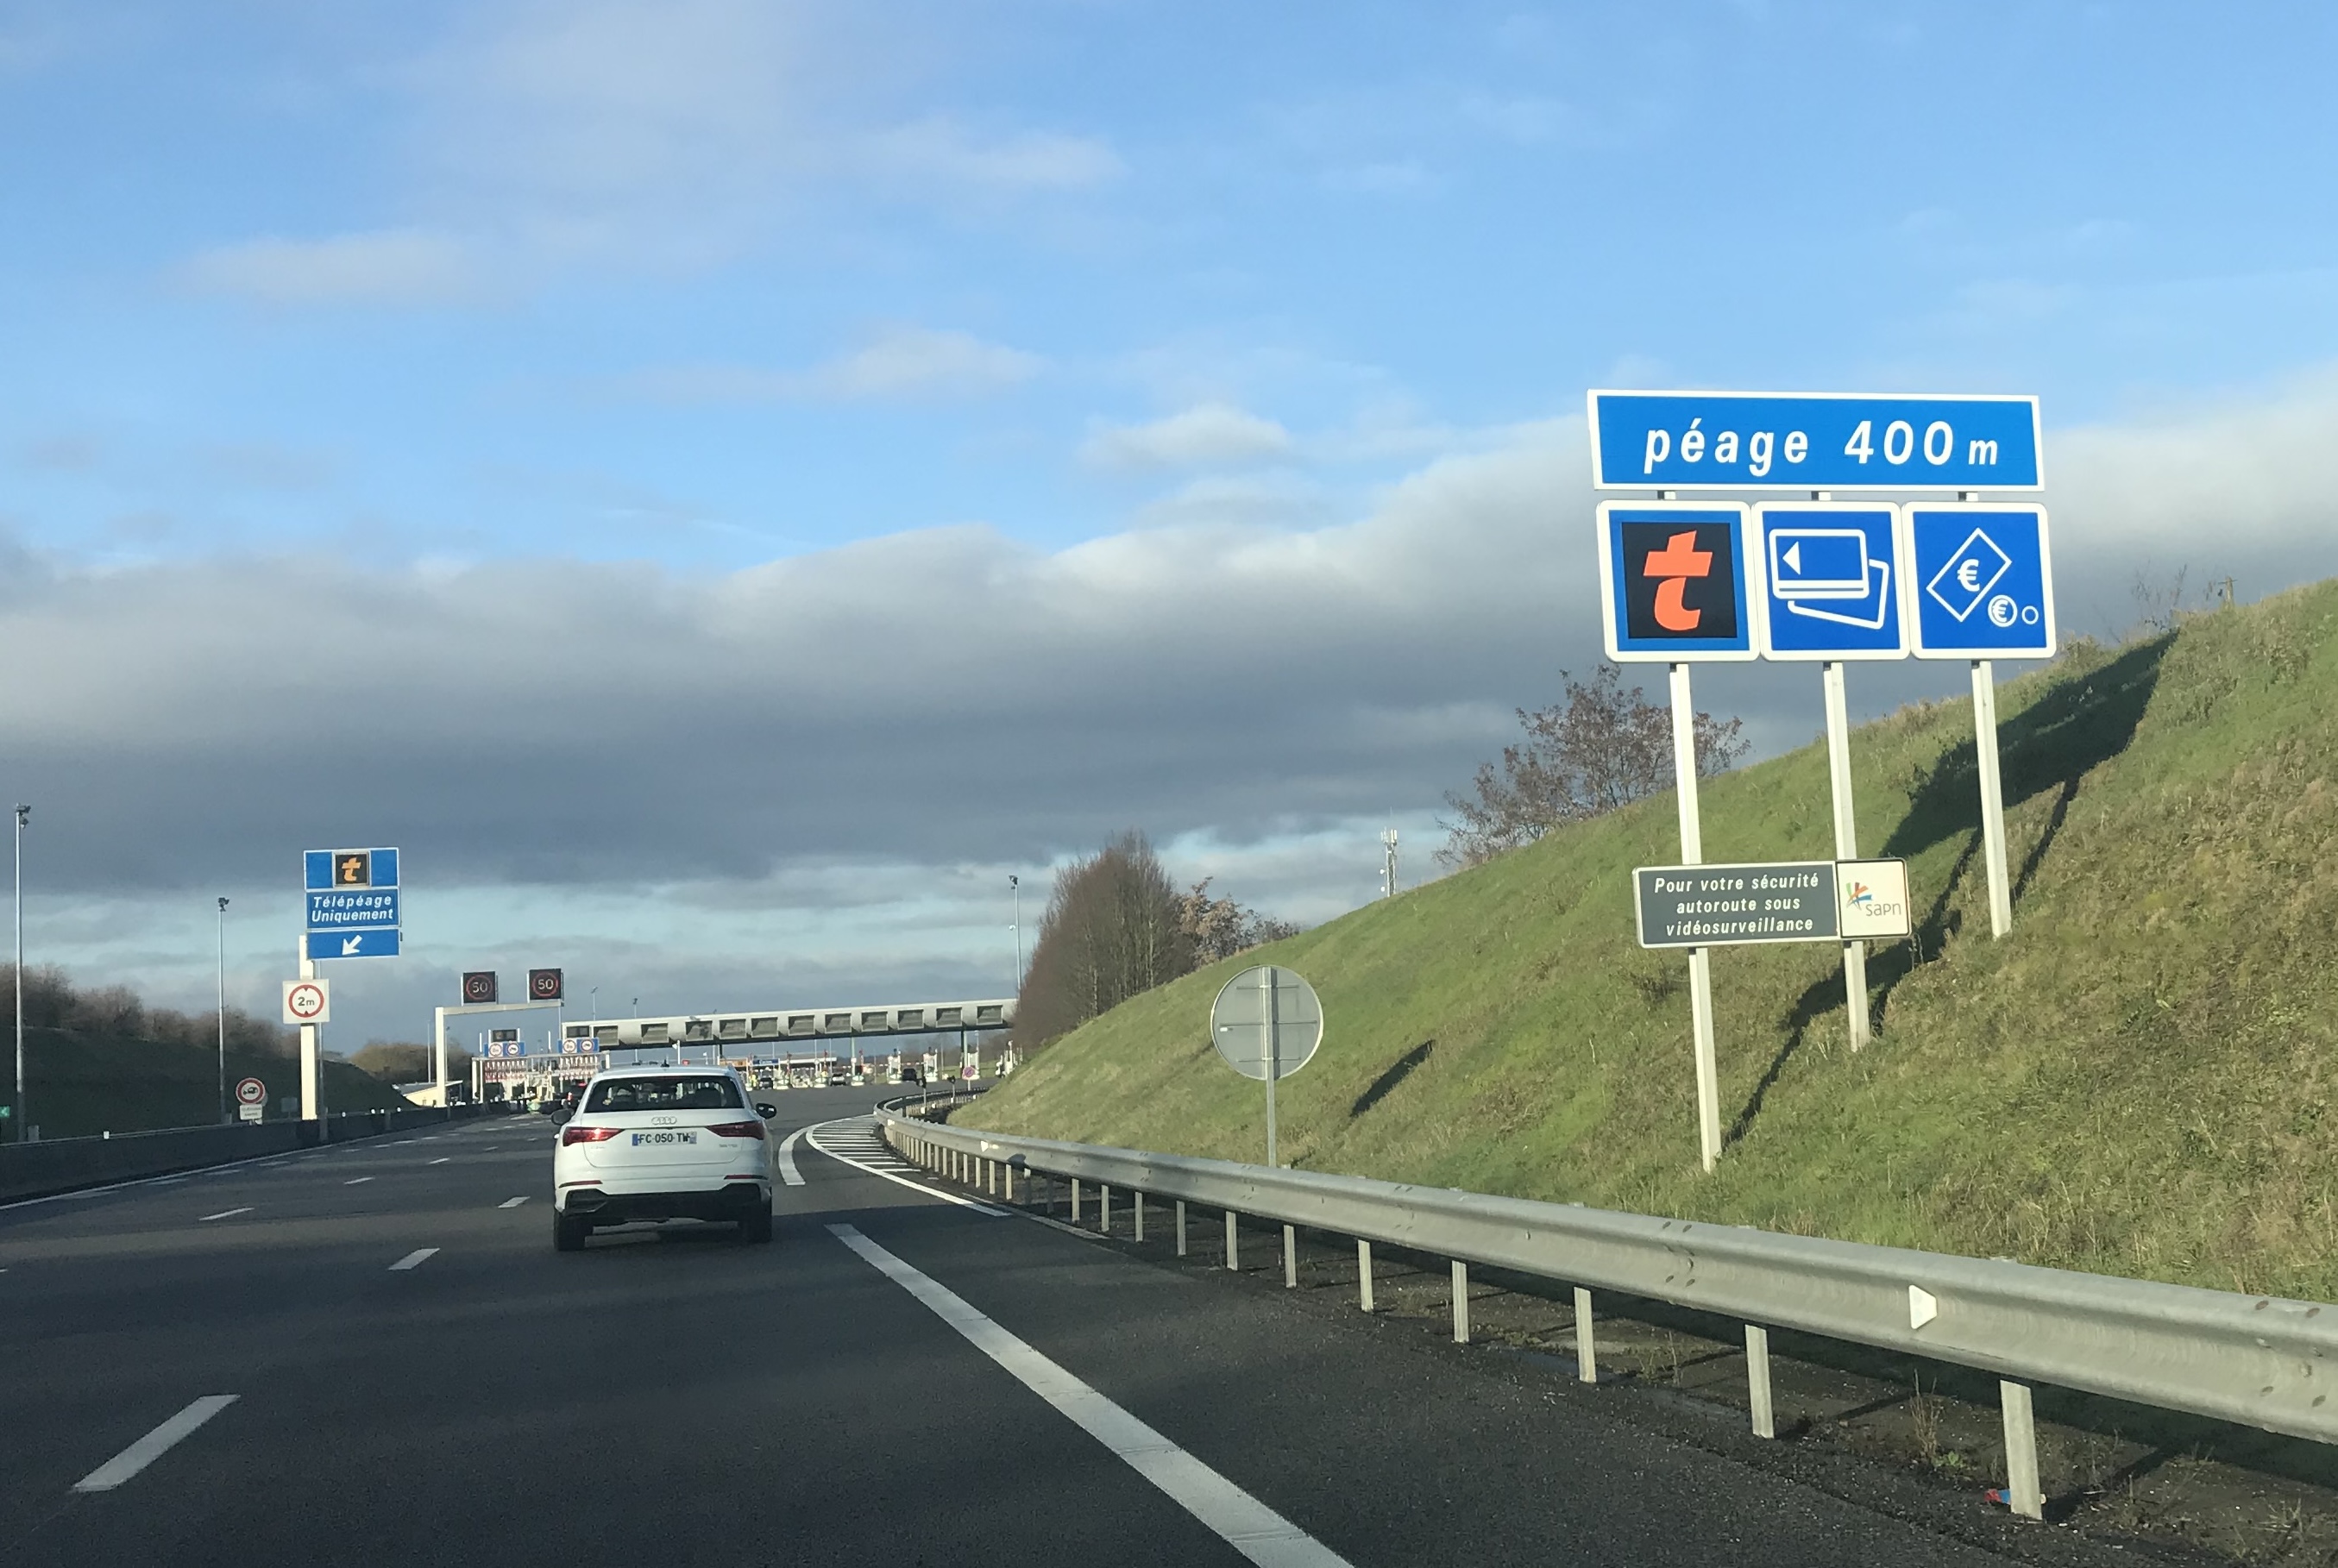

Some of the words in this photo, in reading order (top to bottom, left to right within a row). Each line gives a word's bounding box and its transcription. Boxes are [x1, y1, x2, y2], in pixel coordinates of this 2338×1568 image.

[1644, 417, 1809, 477] péage
[1845, 420, 1953, 466] 400
[1968, 439, 1998, 466] m
[1654, 877, 1693, 893] Pour
[1700, 877, 1744, 891] votre
[1751, 872, 1819, 890] sécurité
[314, 894, 392, 909] Télépéage
[1676, 899, 1757, 914] autoroute
[1764, 896, 1801, 910] sous
[1866, 902, 1901, 917] sapn
[311, 908, 393, 924] Uniquement
[1666, 917, 1813, 937] vidéosurveillance
[472, 982, 487, 993] 50
[537, 978, 553, 990] 50
